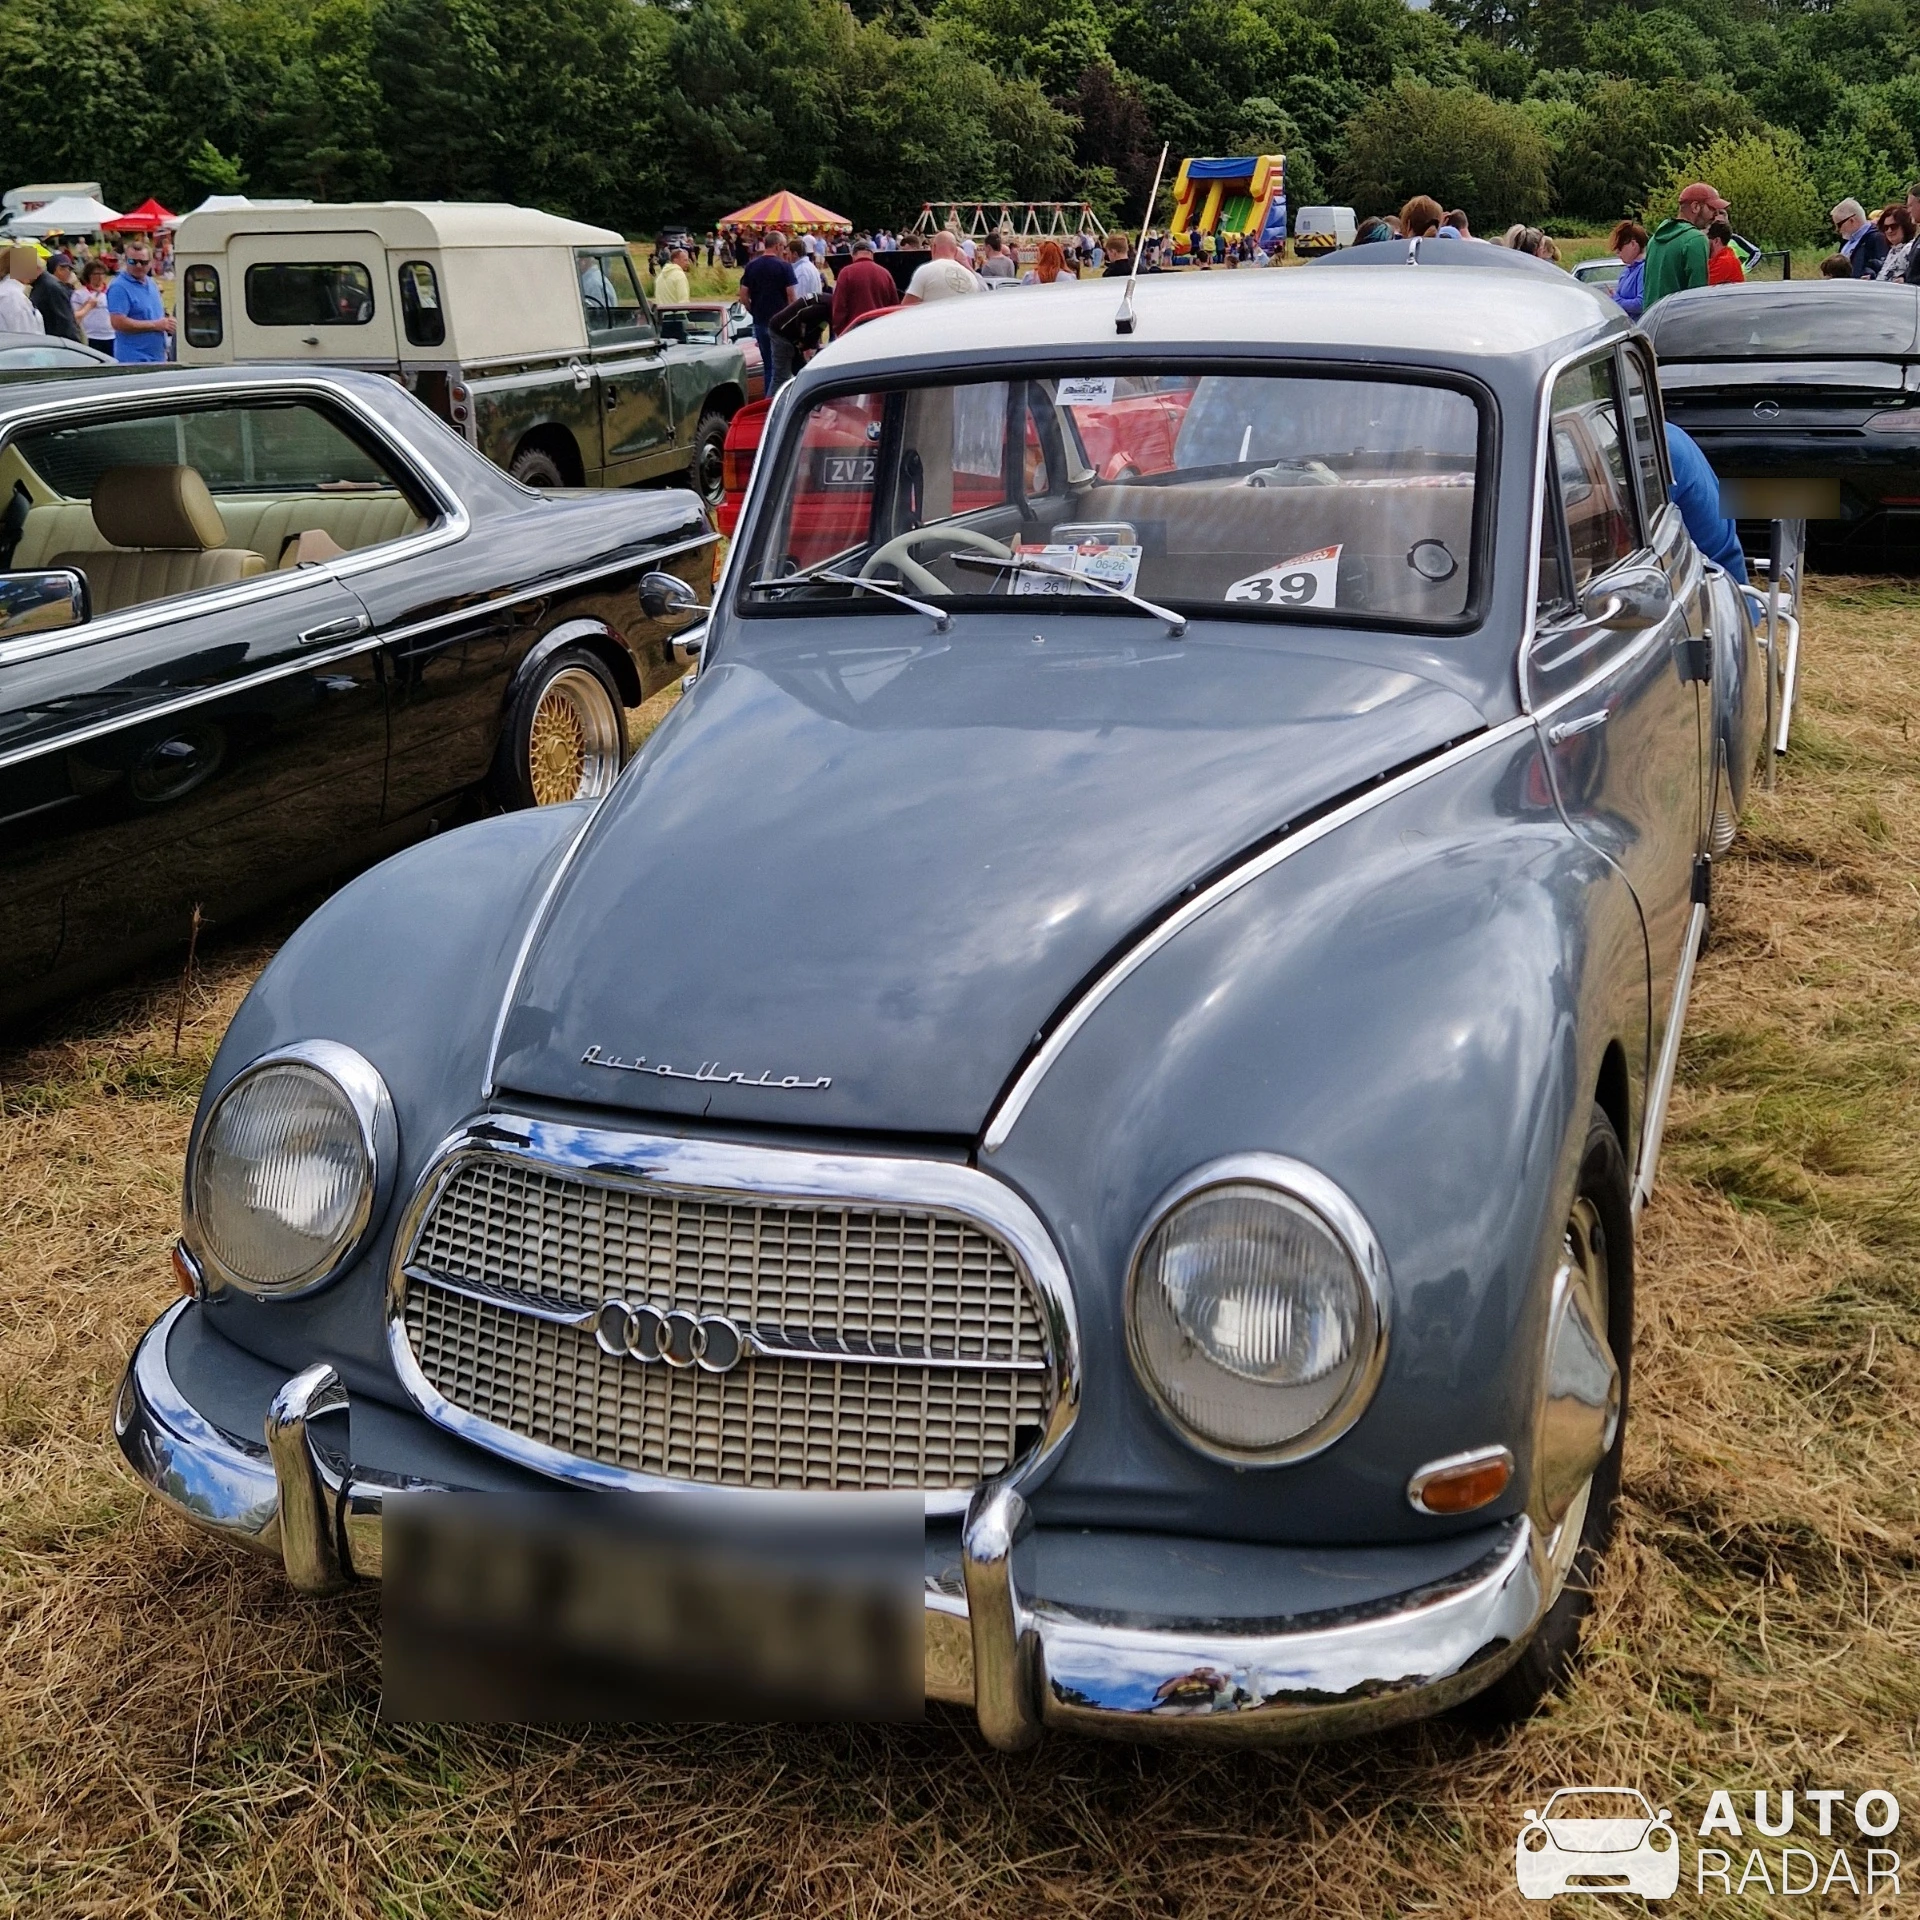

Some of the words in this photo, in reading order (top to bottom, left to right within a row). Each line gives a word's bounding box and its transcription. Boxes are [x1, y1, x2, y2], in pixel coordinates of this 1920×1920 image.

[831, 460, 858, 481] ZV
[862, 460, 875, 481] 2
[1095, 559, 1126, 572] 06-26
[1042, 581, 1060, 593] 26
[1235, 572, 1318, 605] 39
